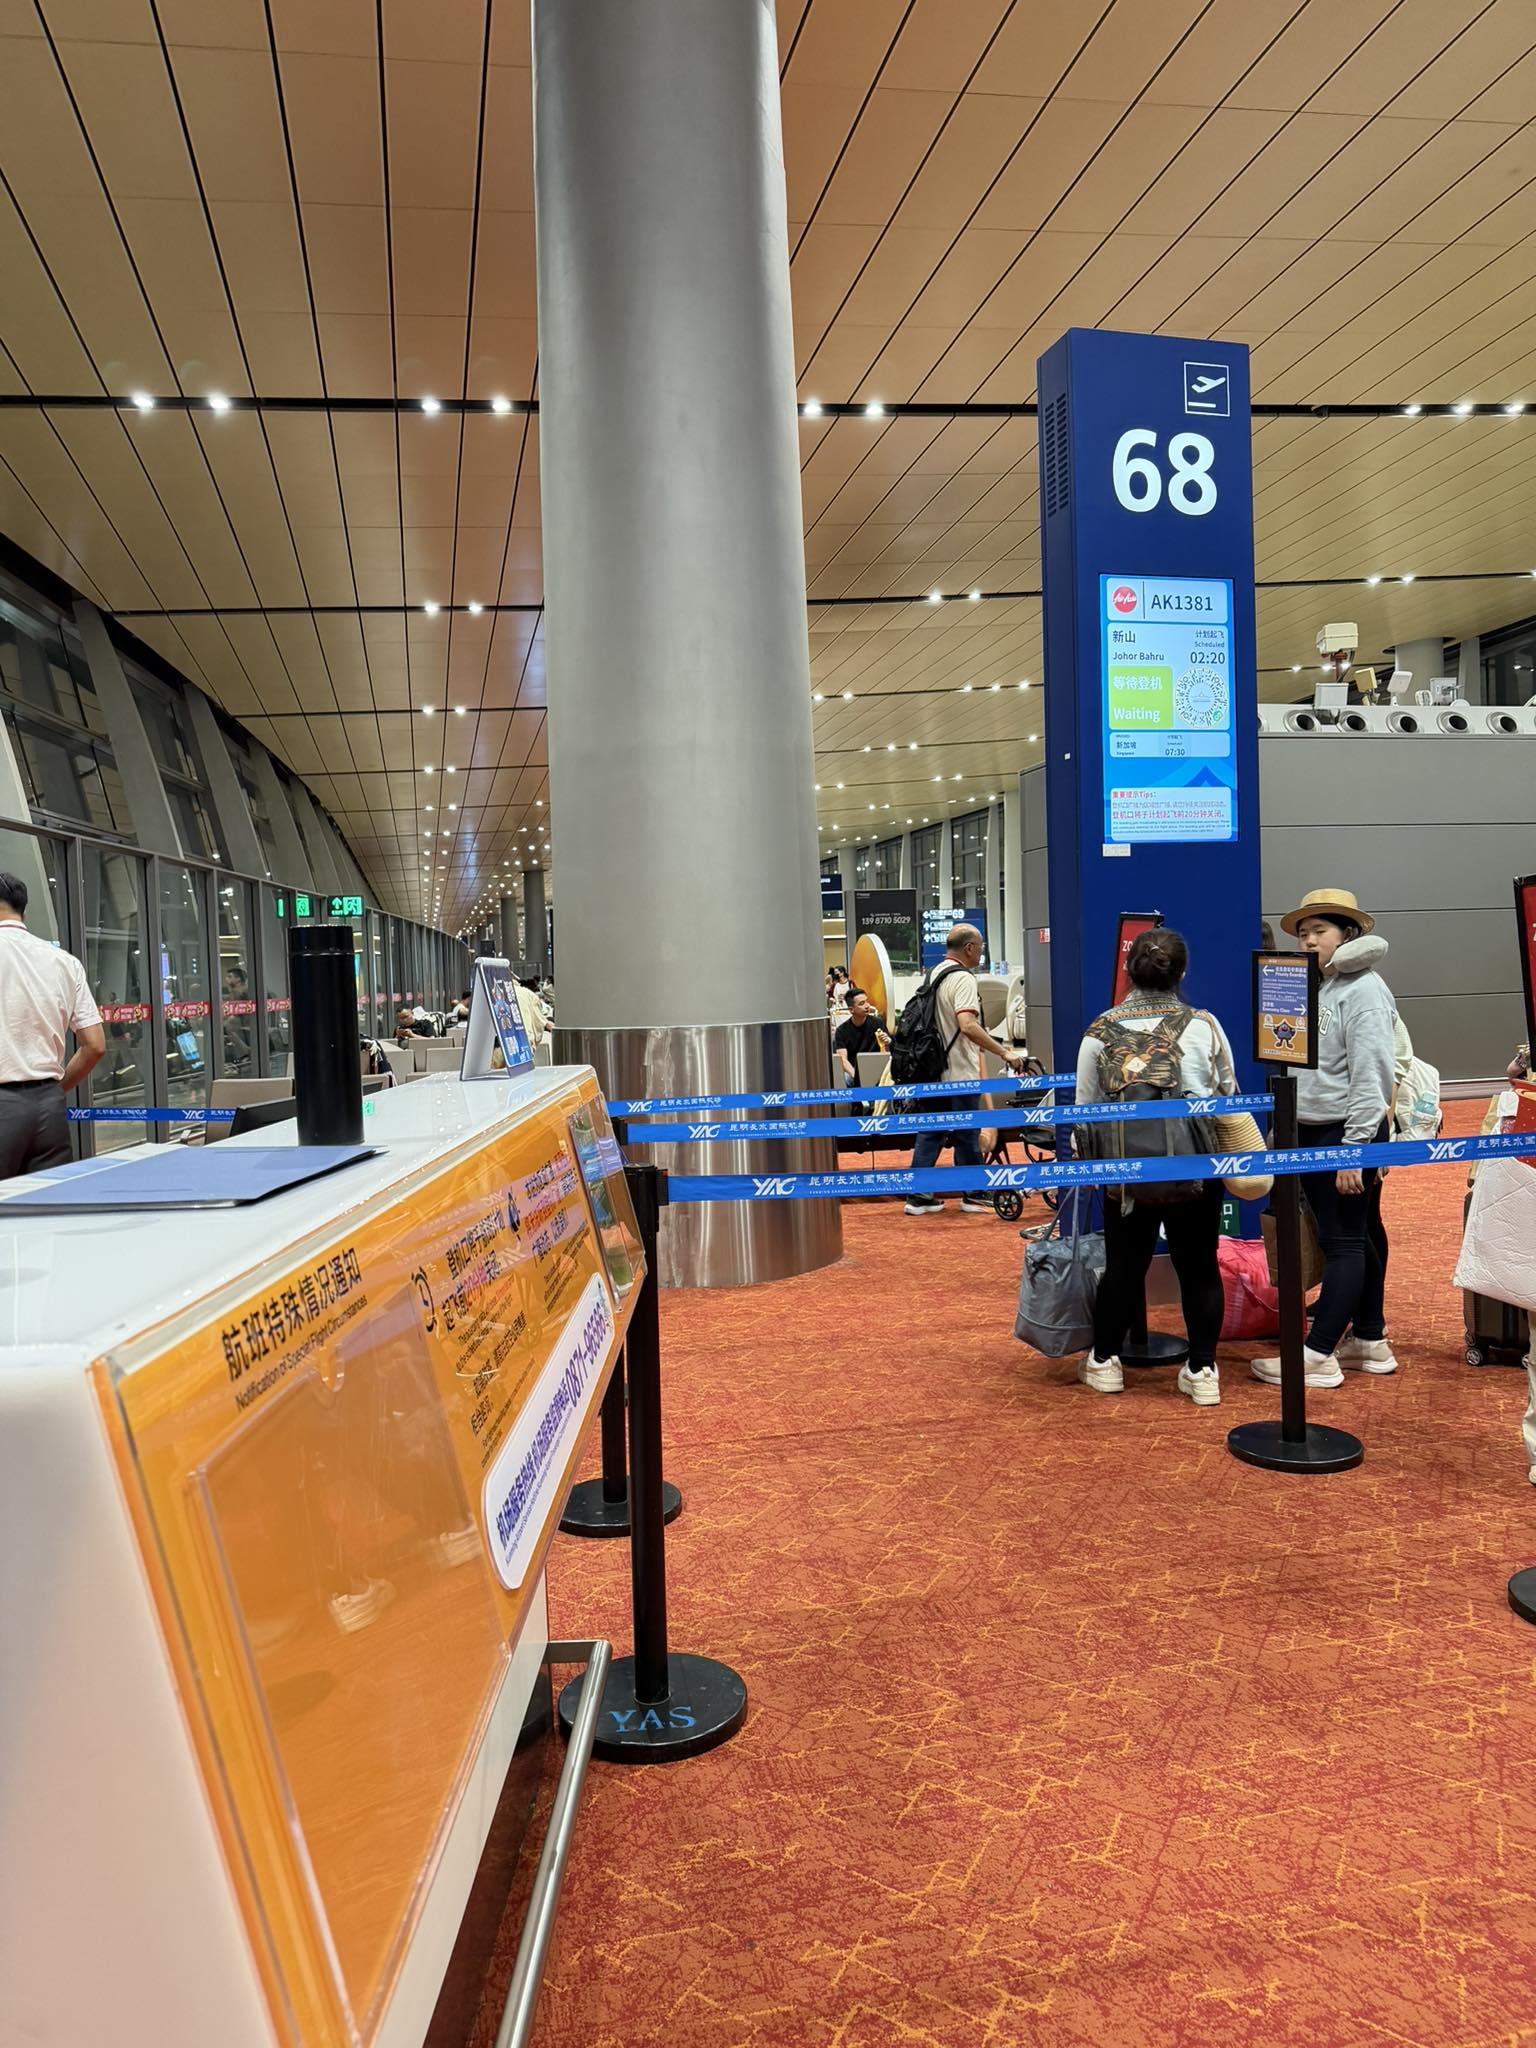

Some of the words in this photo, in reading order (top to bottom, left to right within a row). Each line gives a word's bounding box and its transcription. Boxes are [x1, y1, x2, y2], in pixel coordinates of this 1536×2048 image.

[1112, 429, 1218, 516] 68
[1150, 594, 1214, 611] AK1381
[1112, 630, 1136, 643] 新山
[1195, 630, 1225, 639] 计划起飞
[1112, 652, 1137, 661] Johor
[1140, 652, 1165, 661] Bahru
[1190, 651, 1226, 664] 02:20
[1113, 675, 1162, 689] 等待登机
[1113, 707, 1161, 723] Waiting
[1165, 748, 1186, 756] 07:30
[861, 917, 875, 925] 139
[893, 915, 911, 924] 5029
[952, 908, 966, 919] 69
[222, 1247, 362, 1382] 航班特殊情况通知
[235, 1367, 280, 1413] Notification
[286, 1341, 311, 1371] Special
[310, 1325, 329, 1349] Flight
[327, 1295, 368, 1335] Circumstances
[565, 1302, 607, 1408] 0871-96566
[609, 1705, 697, 1733] YAS
